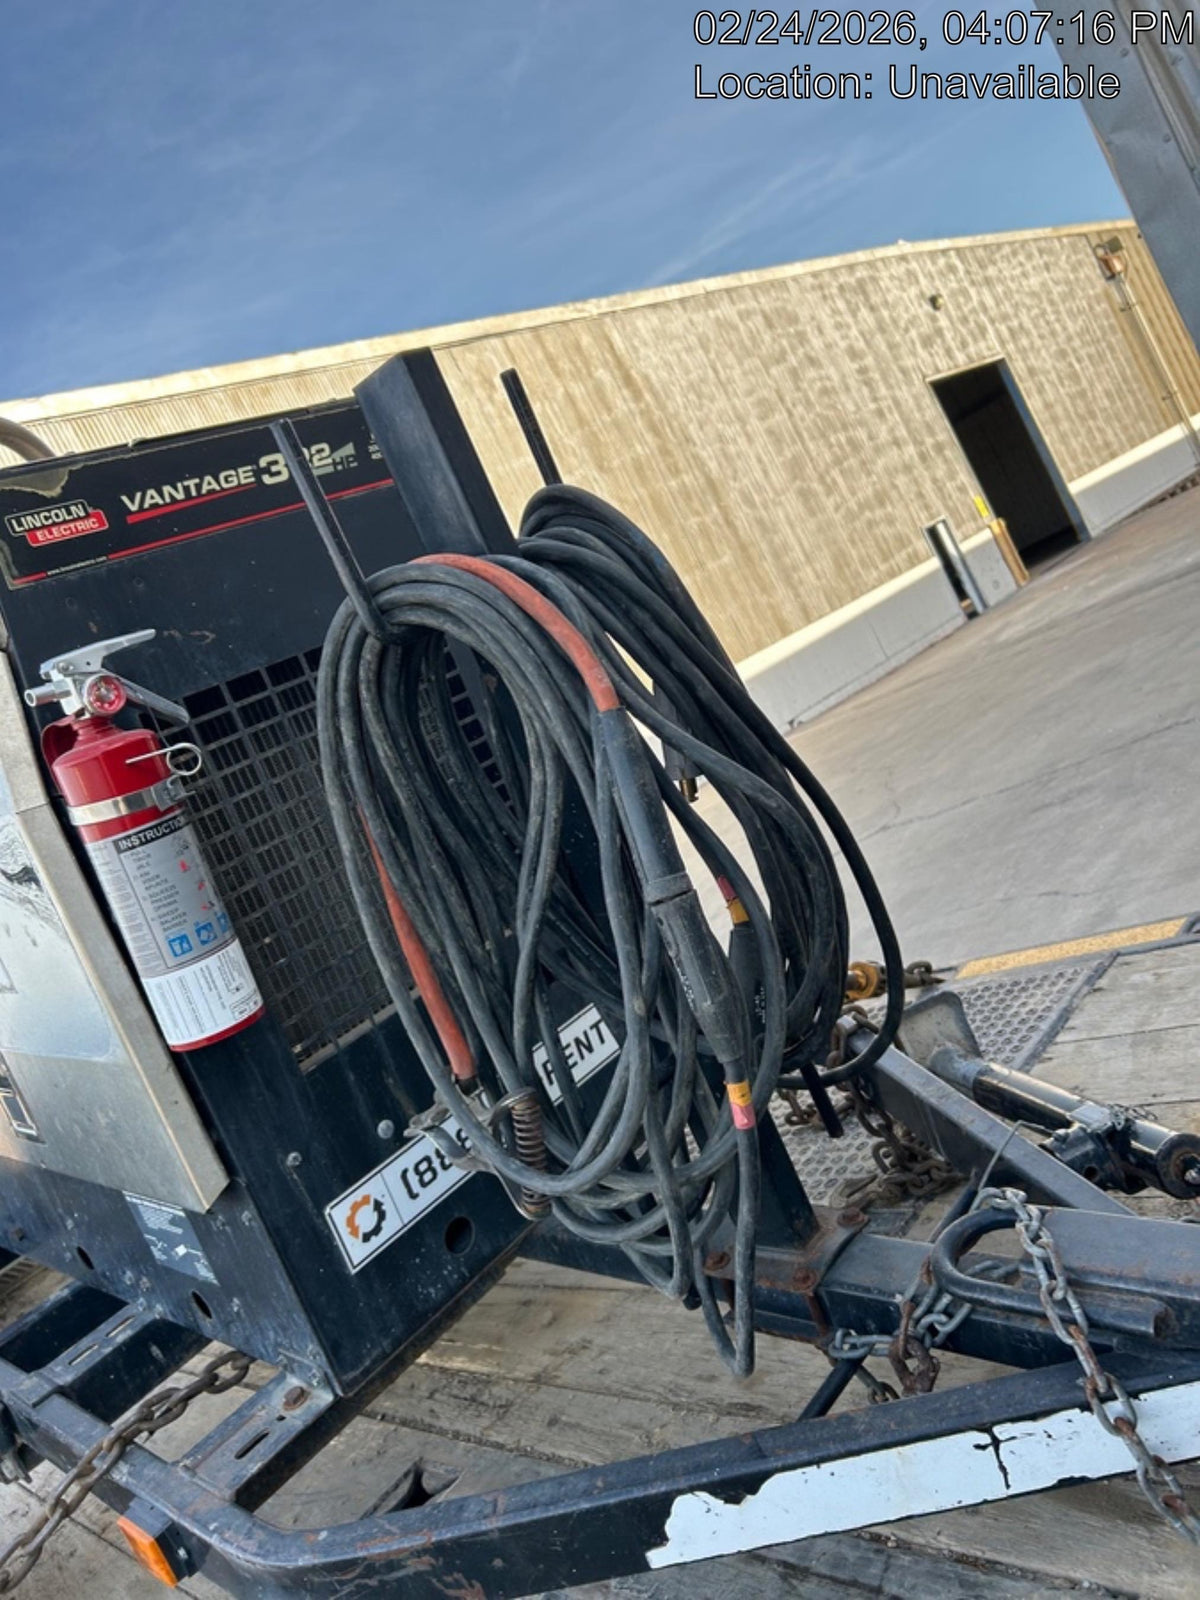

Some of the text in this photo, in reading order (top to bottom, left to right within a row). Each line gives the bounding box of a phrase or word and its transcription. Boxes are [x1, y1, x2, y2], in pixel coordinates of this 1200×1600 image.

[121, 466, 256, 511] VANTAGE
[259, 442, 332, 485] 32
[11, 505, 86, 532] LINCOLN
[36, 518, 99, 541] ELECTRIC
